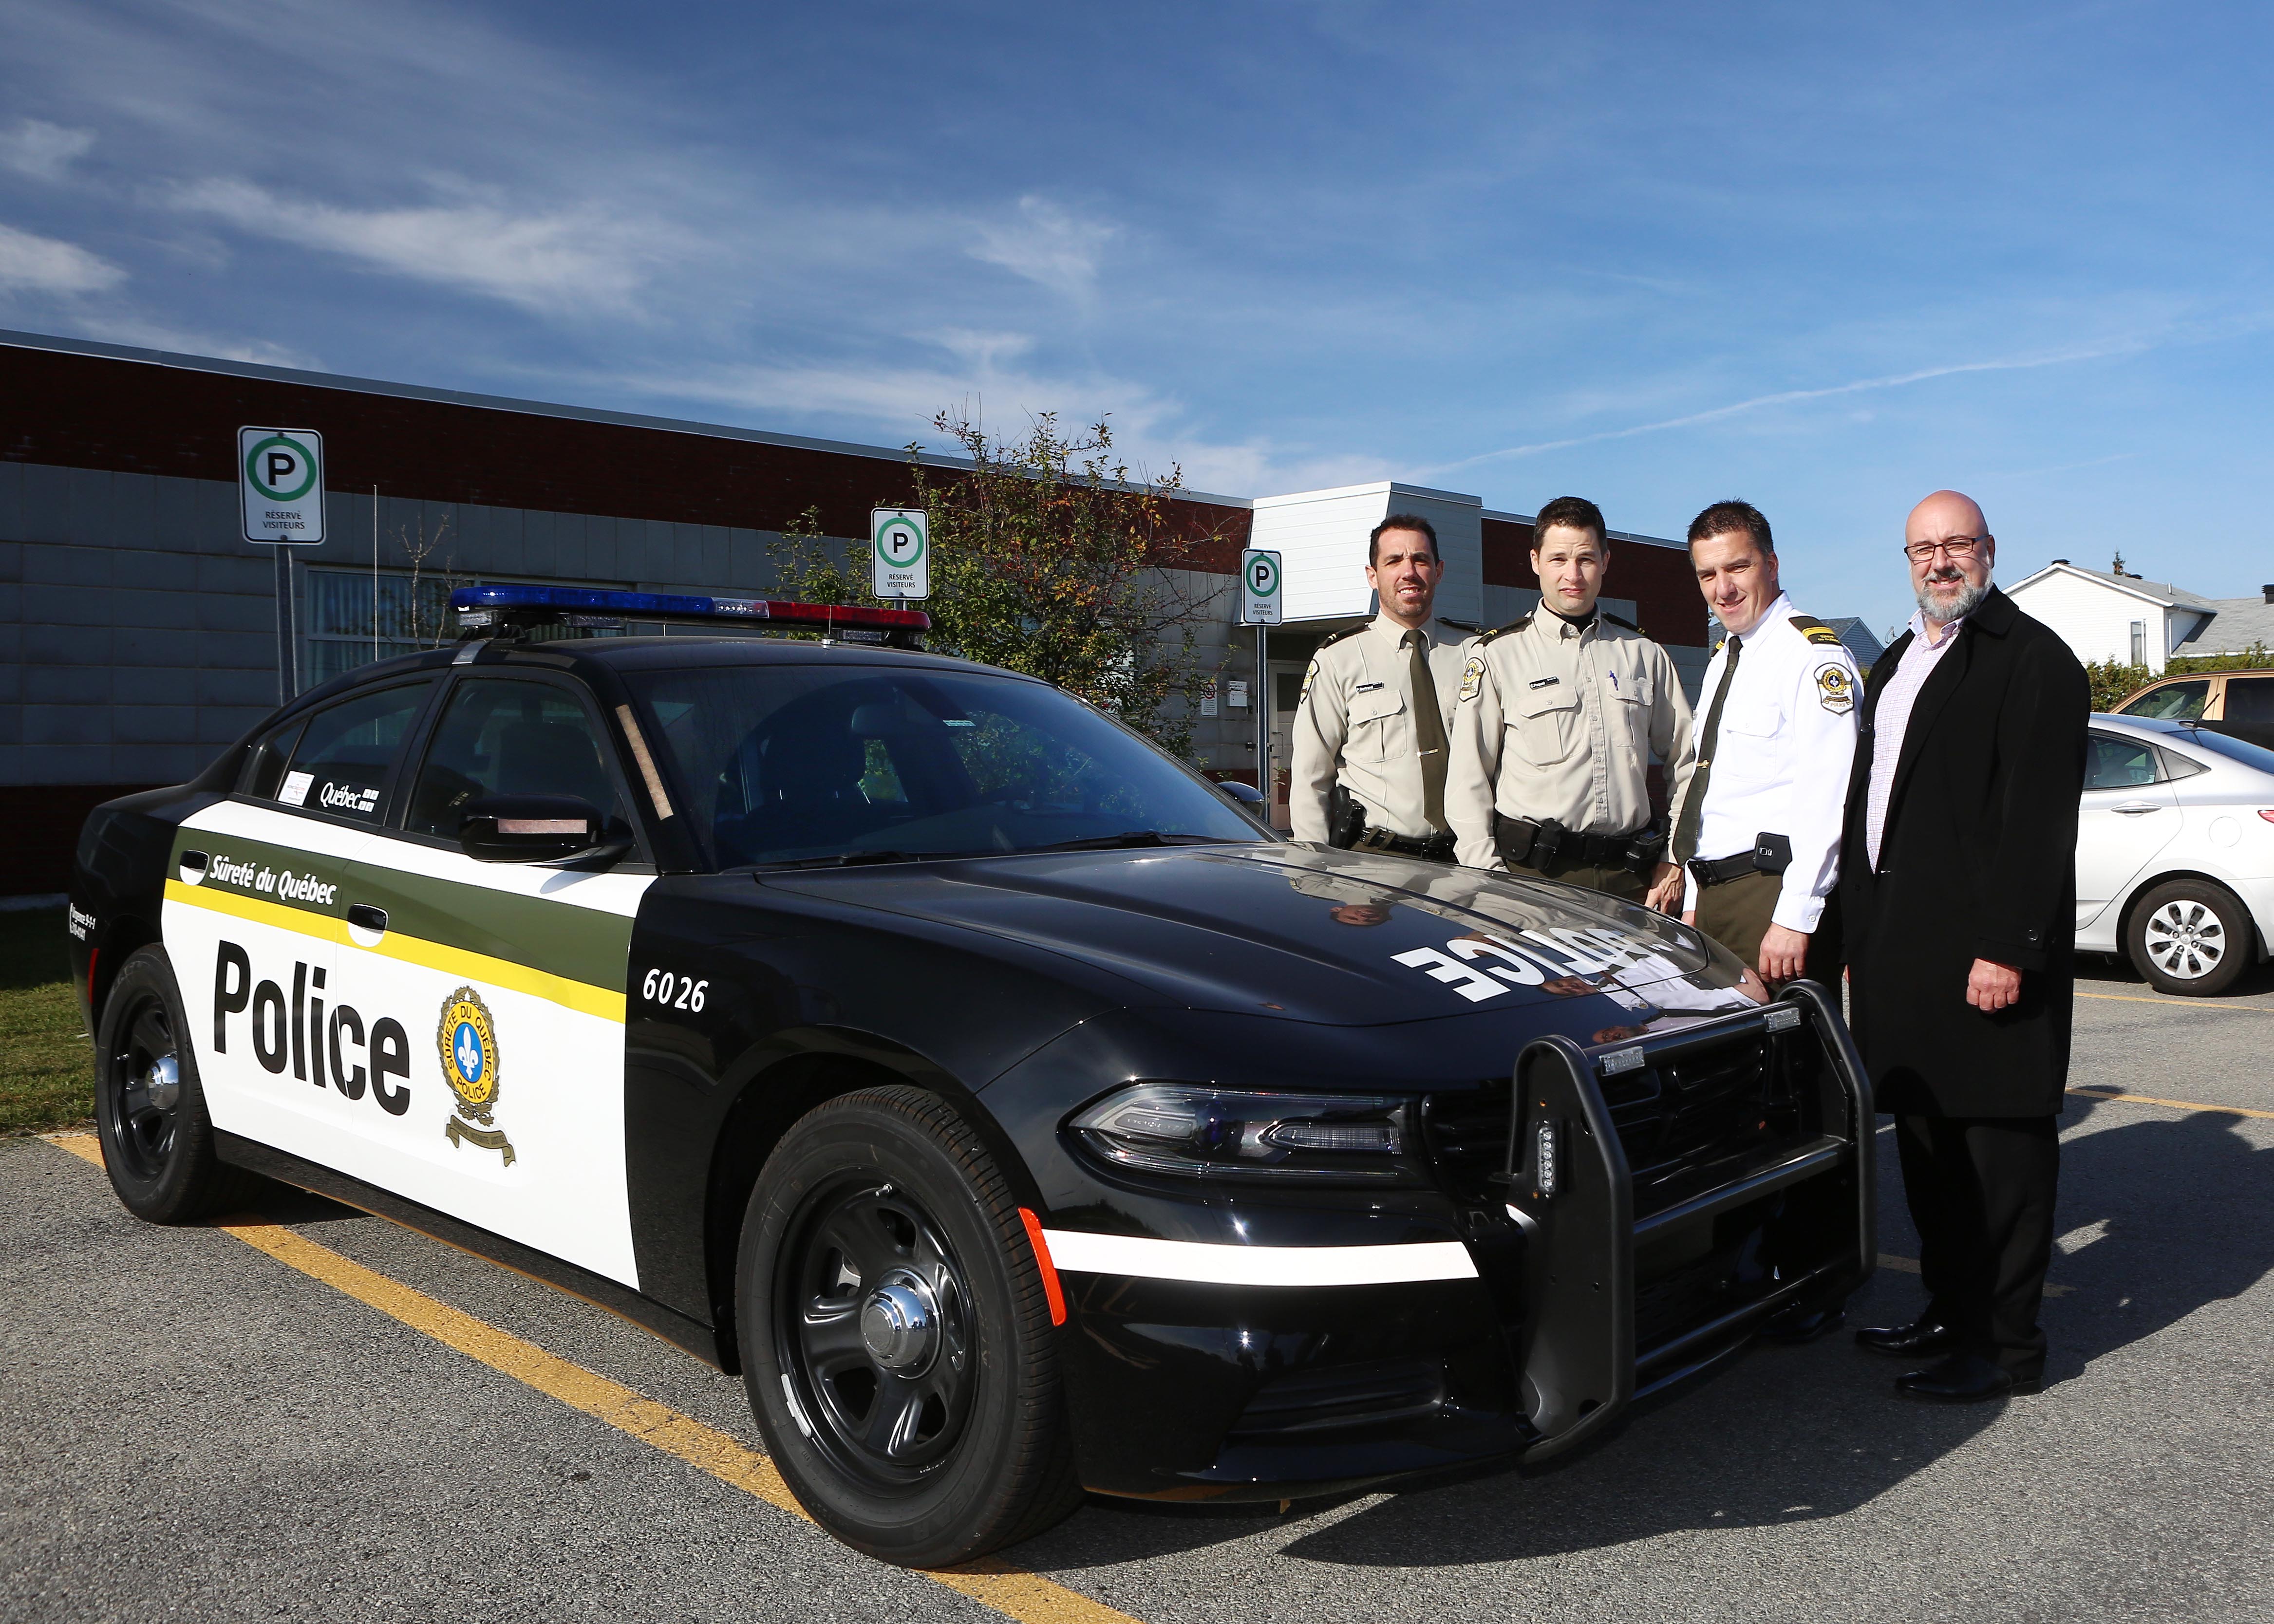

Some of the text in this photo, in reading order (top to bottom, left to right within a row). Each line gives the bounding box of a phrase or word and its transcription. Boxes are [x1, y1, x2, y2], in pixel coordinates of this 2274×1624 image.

[267, 452, 296, 486] P
[263, 521, 305, 529] VISITEURS
[265, 510, 302, 520] RÉSERVÉ
[893, 532, 908, 553] P
[889, 572, 914, 580] RÉSERVÉ
[1256, 565, 1269, 587] P
[320, 782, 361, 809] Québec
[209, 855, 337, 905] Sûreté du Québec
[643, 968, 709, 1013] 6026
[213, 939, 411, 1116] Police
[444, 1006, 492, 1081] SÛRETÉ DU QUÉBEC
[456, 1076, 486, 1100] POLICE
